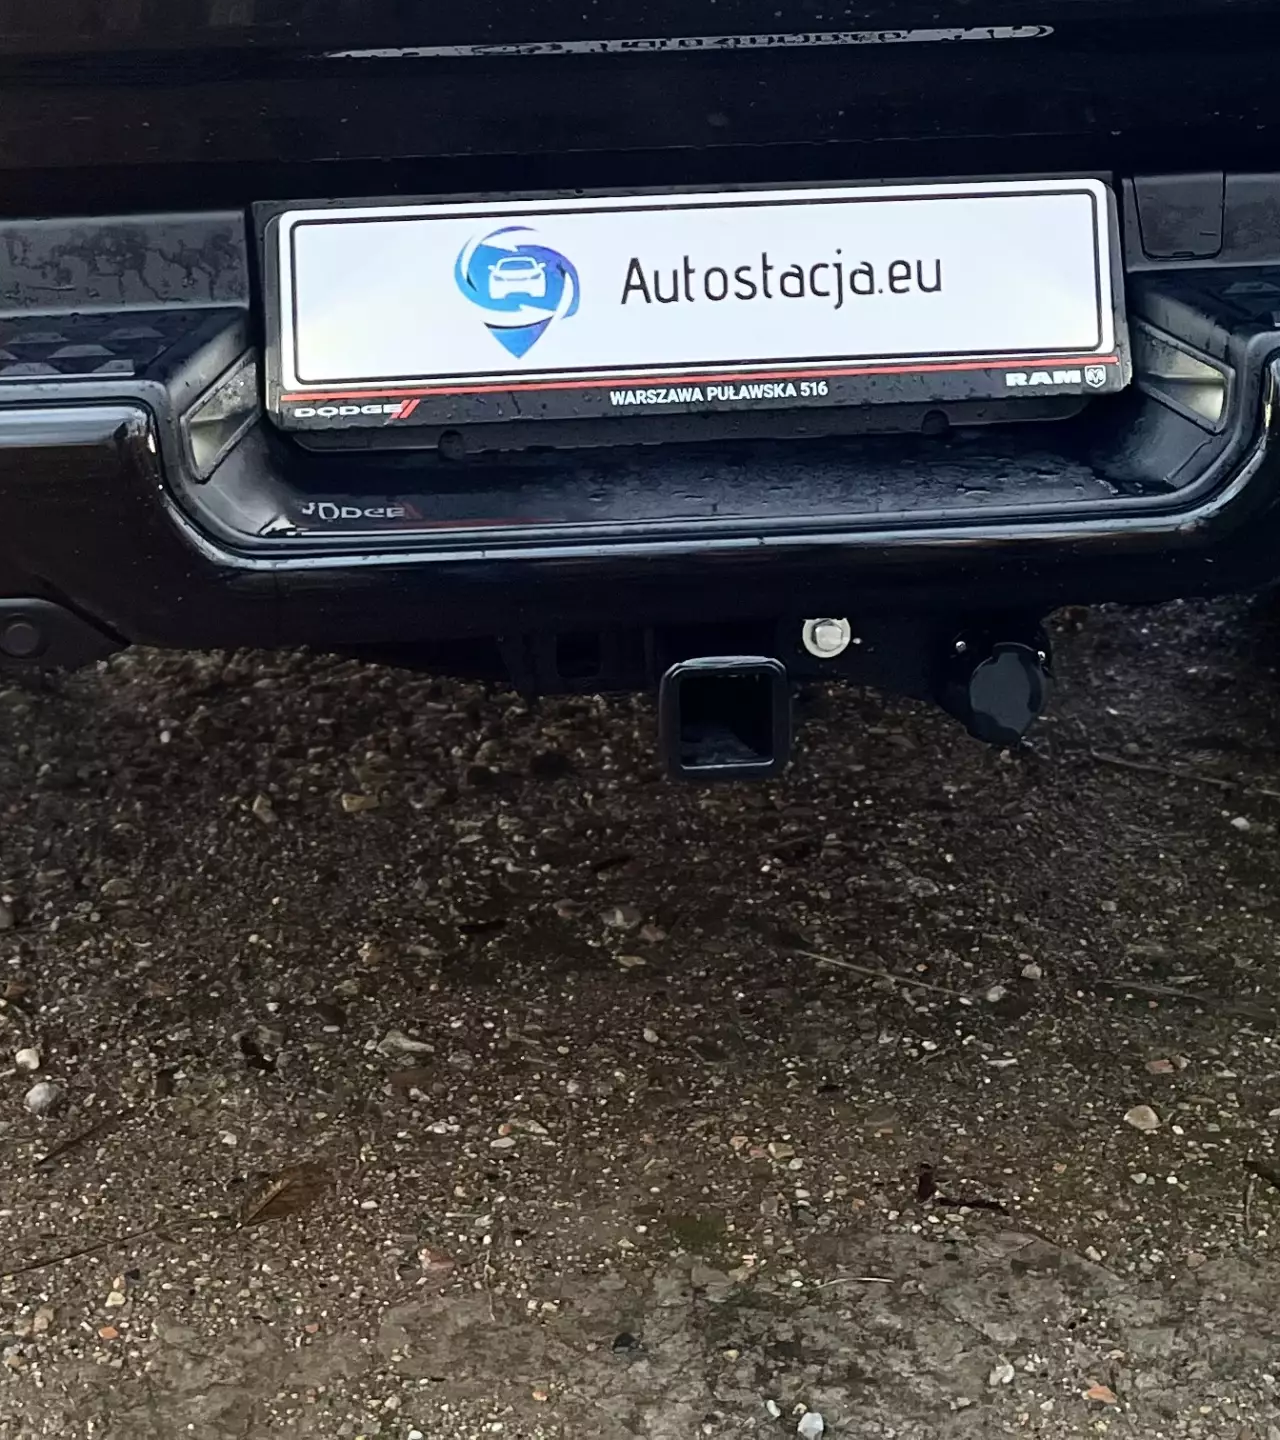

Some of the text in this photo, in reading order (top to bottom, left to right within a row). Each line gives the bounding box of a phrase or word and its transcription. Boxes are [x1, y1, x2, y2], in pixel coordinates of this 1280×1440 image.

[620, 248, 943, 310] Autostacja.eu
[1005, 369, 1082, 387] RAM
[609, 380, 829, 406] WARSZAWA PUŁAWSKA 516
[294, 403, 406, 418] DODGE
